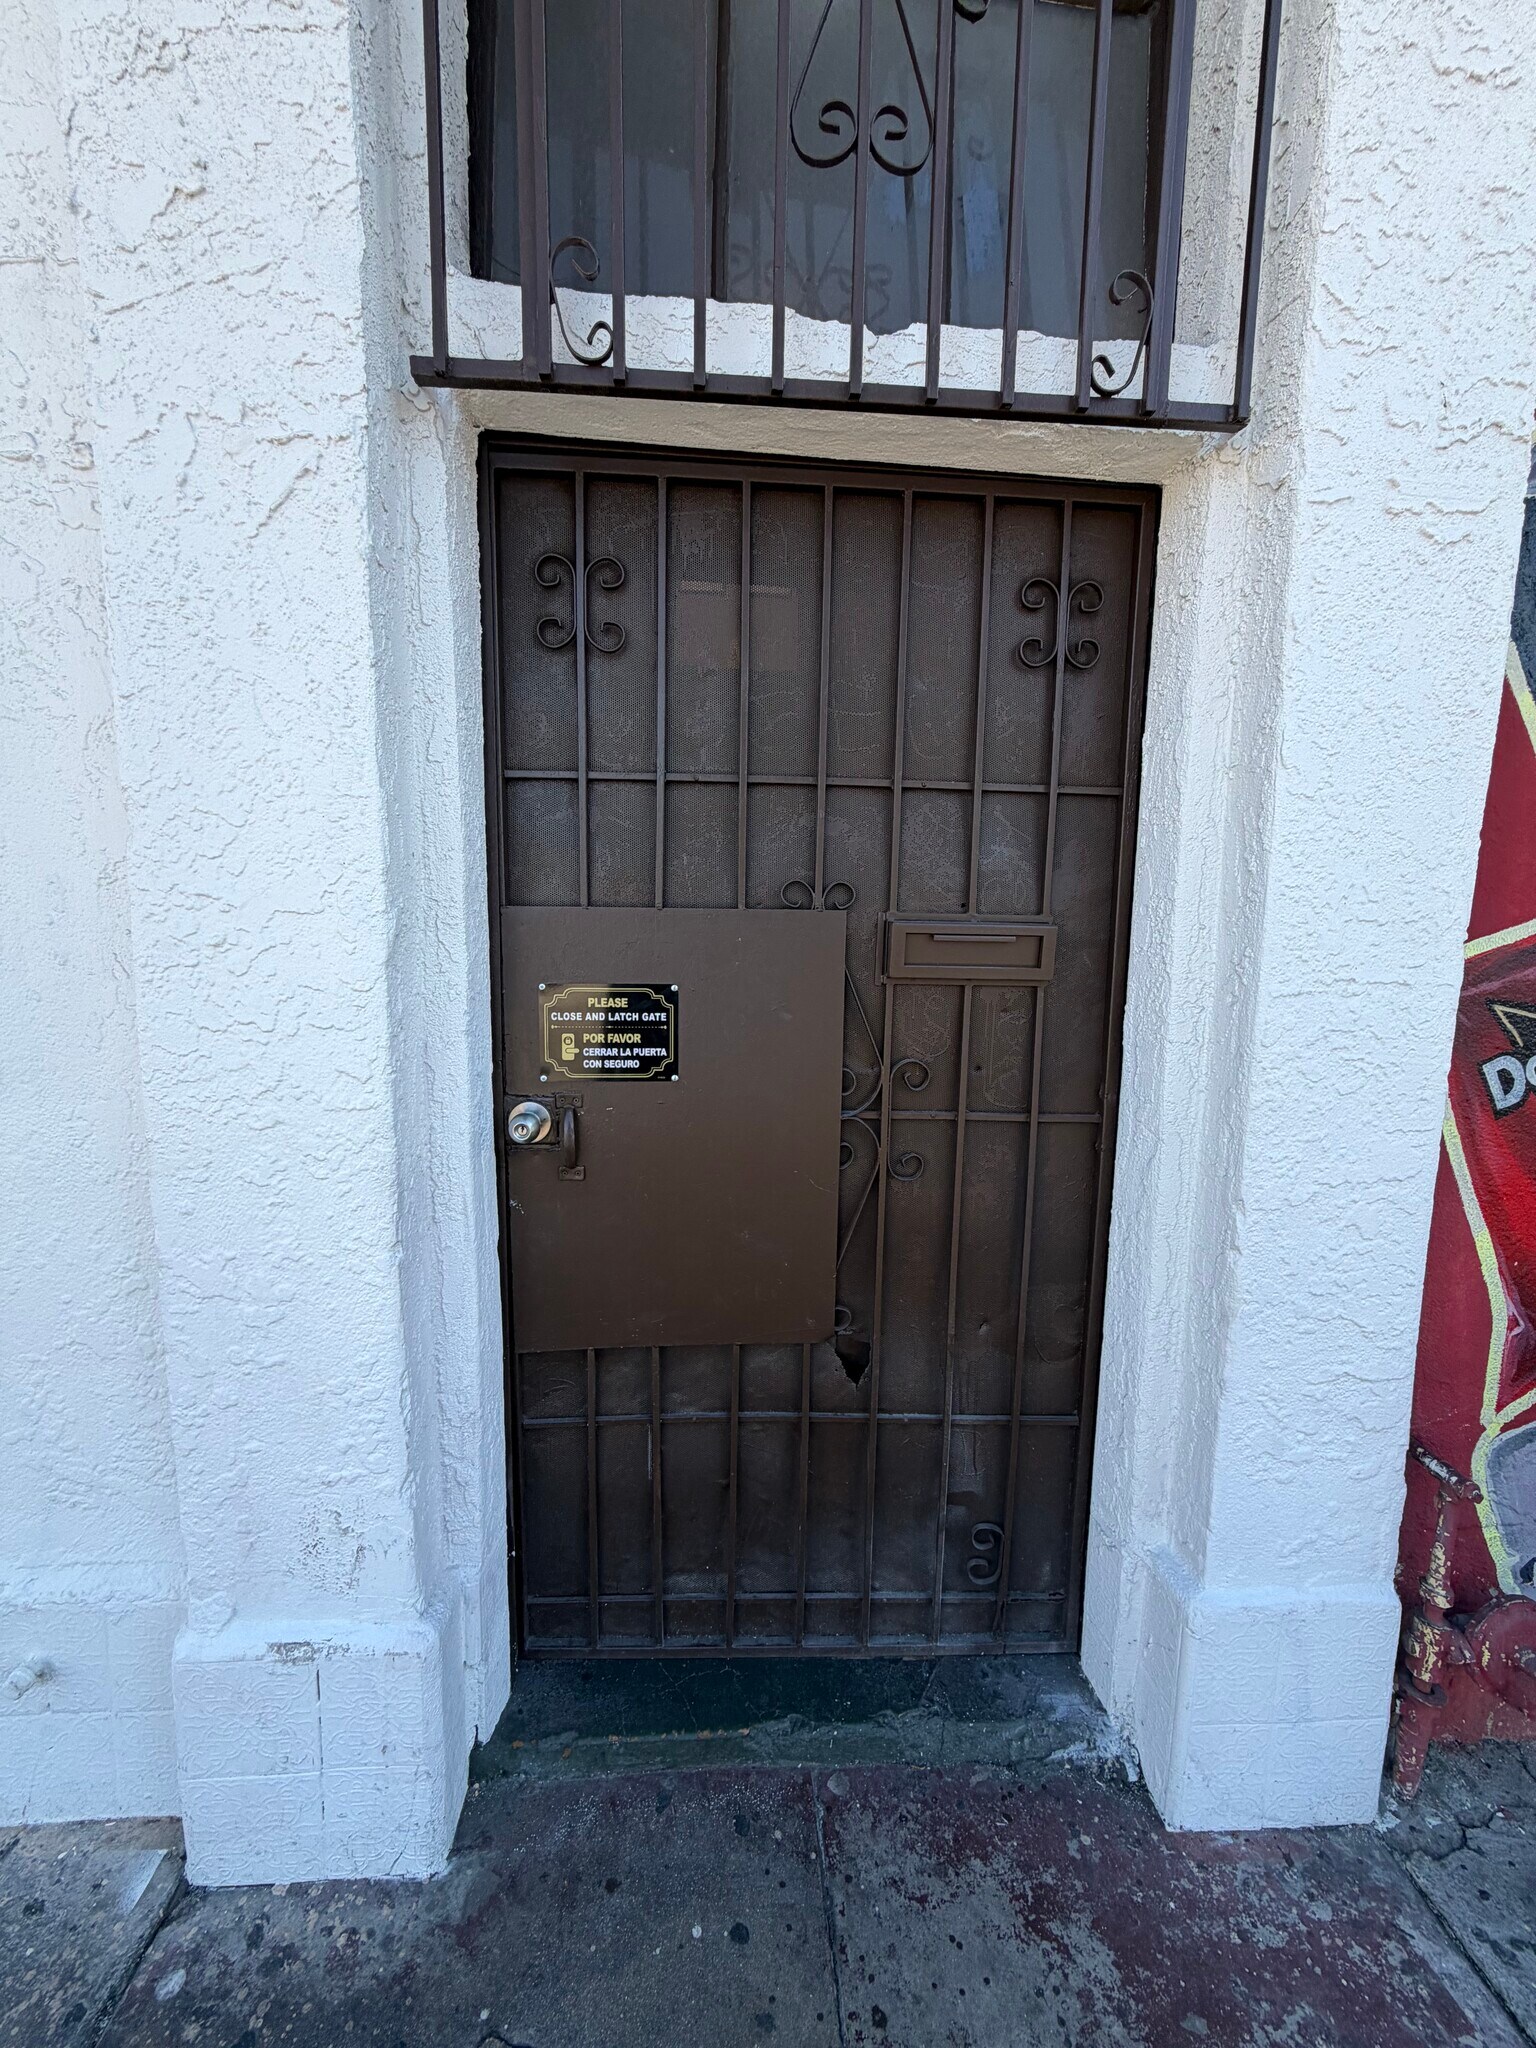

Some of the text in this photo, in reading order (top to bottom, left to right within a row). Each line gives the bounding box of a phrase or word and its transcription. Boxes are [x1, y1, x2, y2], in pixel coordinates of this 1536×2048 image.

[588, 998, 628, 1008] PLEASE
[551, 1012, 667, 1021] CLOSE AND LATCH GATE
[583, 1033, 641, 1043] POR FAVOR
[583, 1048, 667, 1056] CERRAR LA PUERTA
[583, 1060, 640, 1068] CON SEGURO
